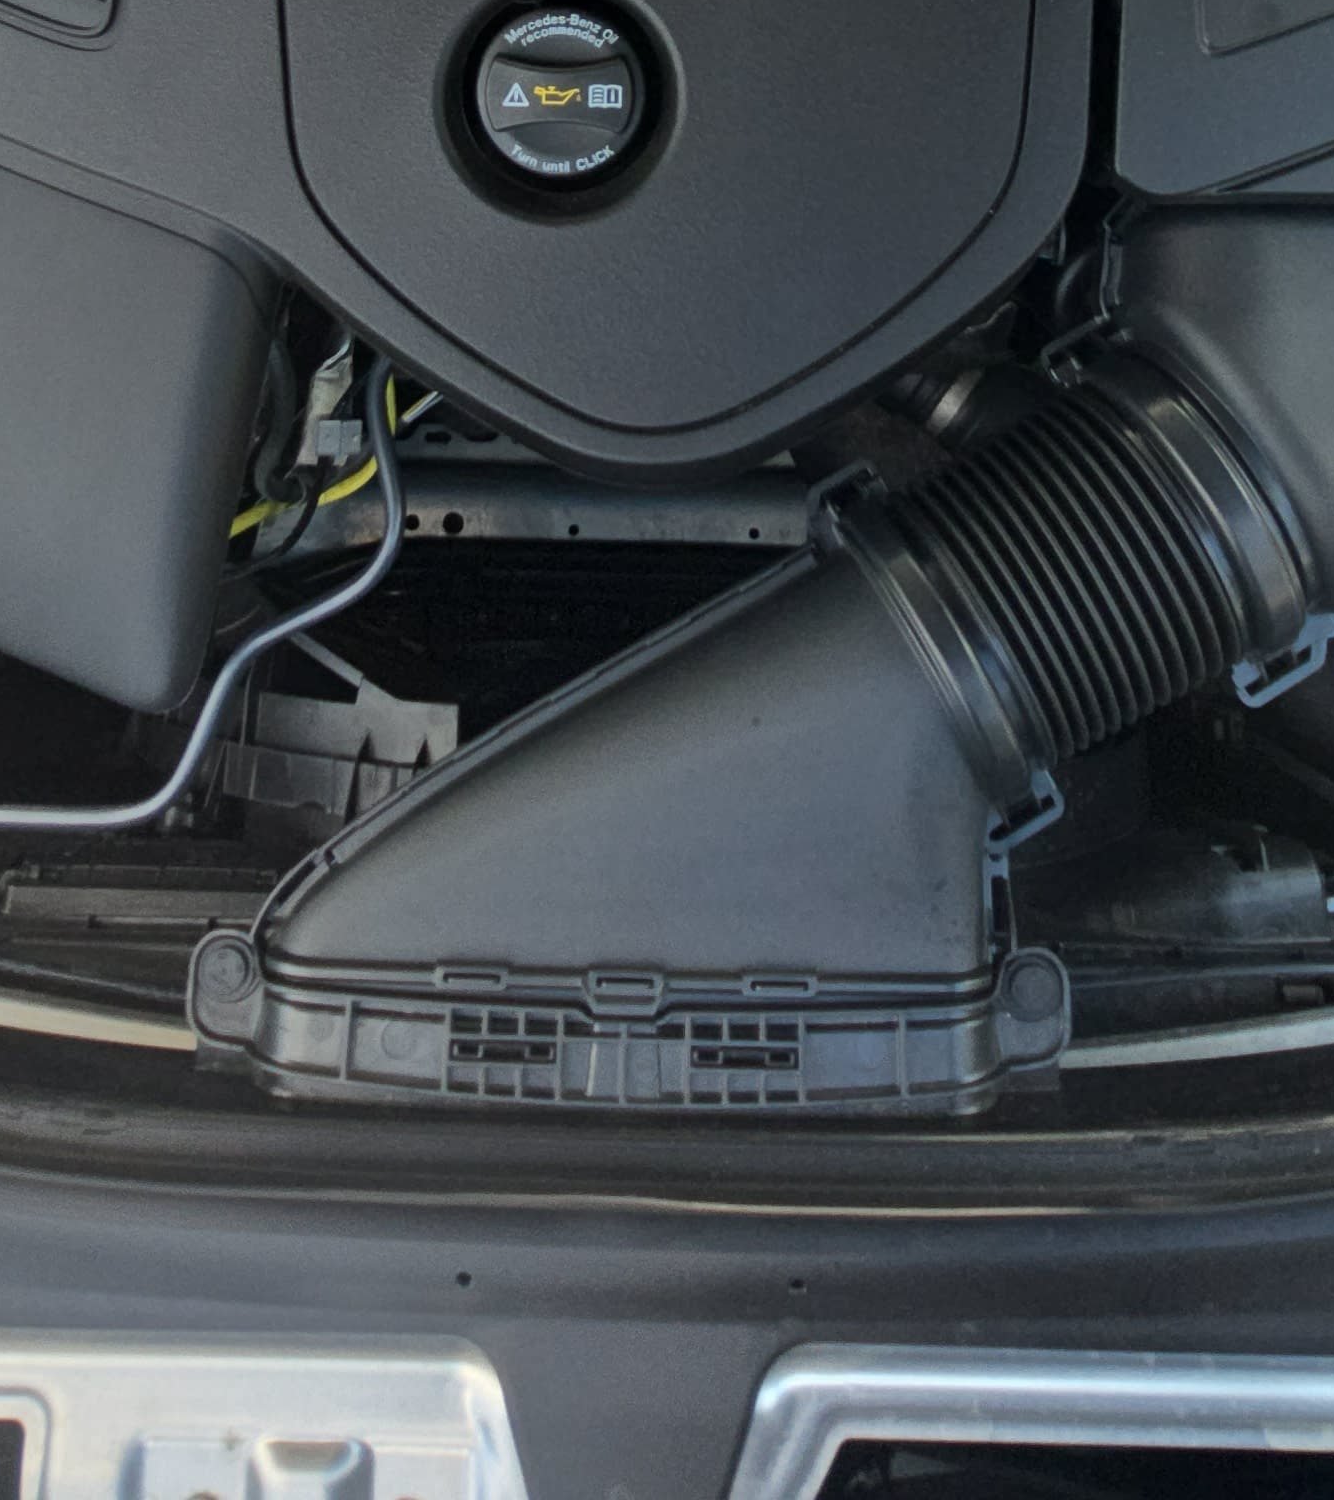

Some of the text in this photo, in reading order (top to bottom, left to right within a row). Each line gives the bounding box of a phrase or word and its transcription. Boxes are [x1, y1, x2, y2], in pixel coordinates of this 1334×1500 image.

[504, 13, 619, 45] Mercedes-Benz Oil
[521, 26, 604, 48] recommended
[511, 143, 614, 173] Turn until CLICK
